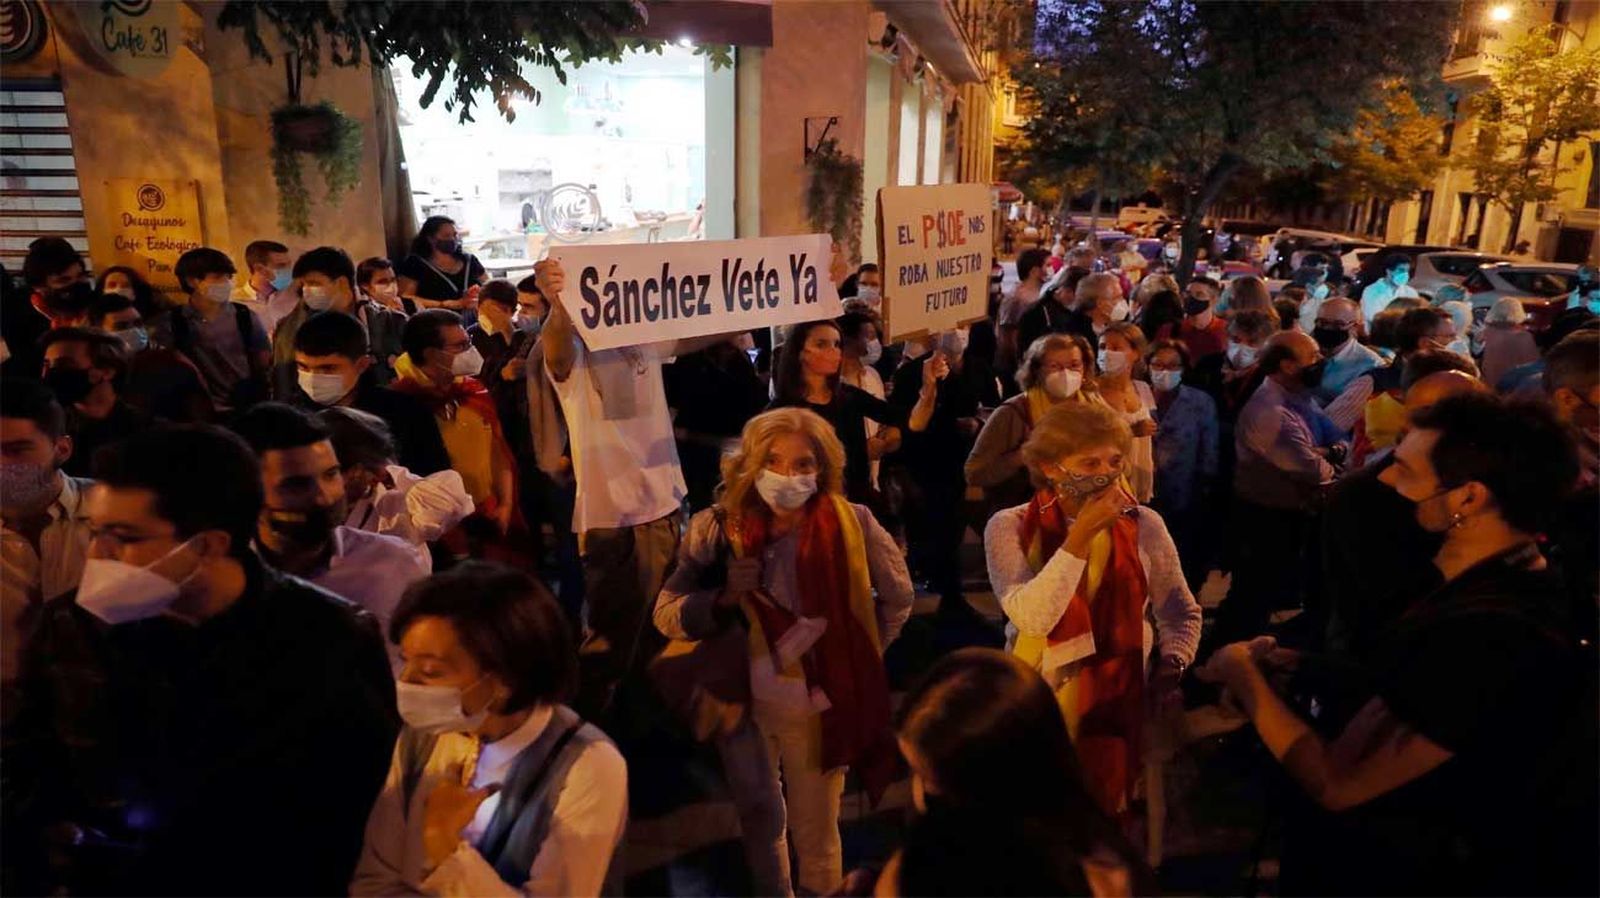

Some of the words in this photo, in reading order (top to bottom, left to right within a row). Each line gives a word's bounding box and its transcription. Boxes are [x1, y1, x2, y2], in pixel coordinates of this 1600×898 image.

[102, 15, 147, 58] Café
[150, 25, 168, 54] 31
[121, 212, 186, 231] Desayunos
[897, 225, 915, 245] EL
[968, 214, 985, 234] NOS
[899, 262, 929, 286] ROBA
[936, 252, 982, 279] NUESTRO
[579, 262, 711, 330] Sánchez
[722, 257, 780, 312] Vete
[789, 253, 818, 304] Ya
[925, 285, 968, 313] FUTURO
